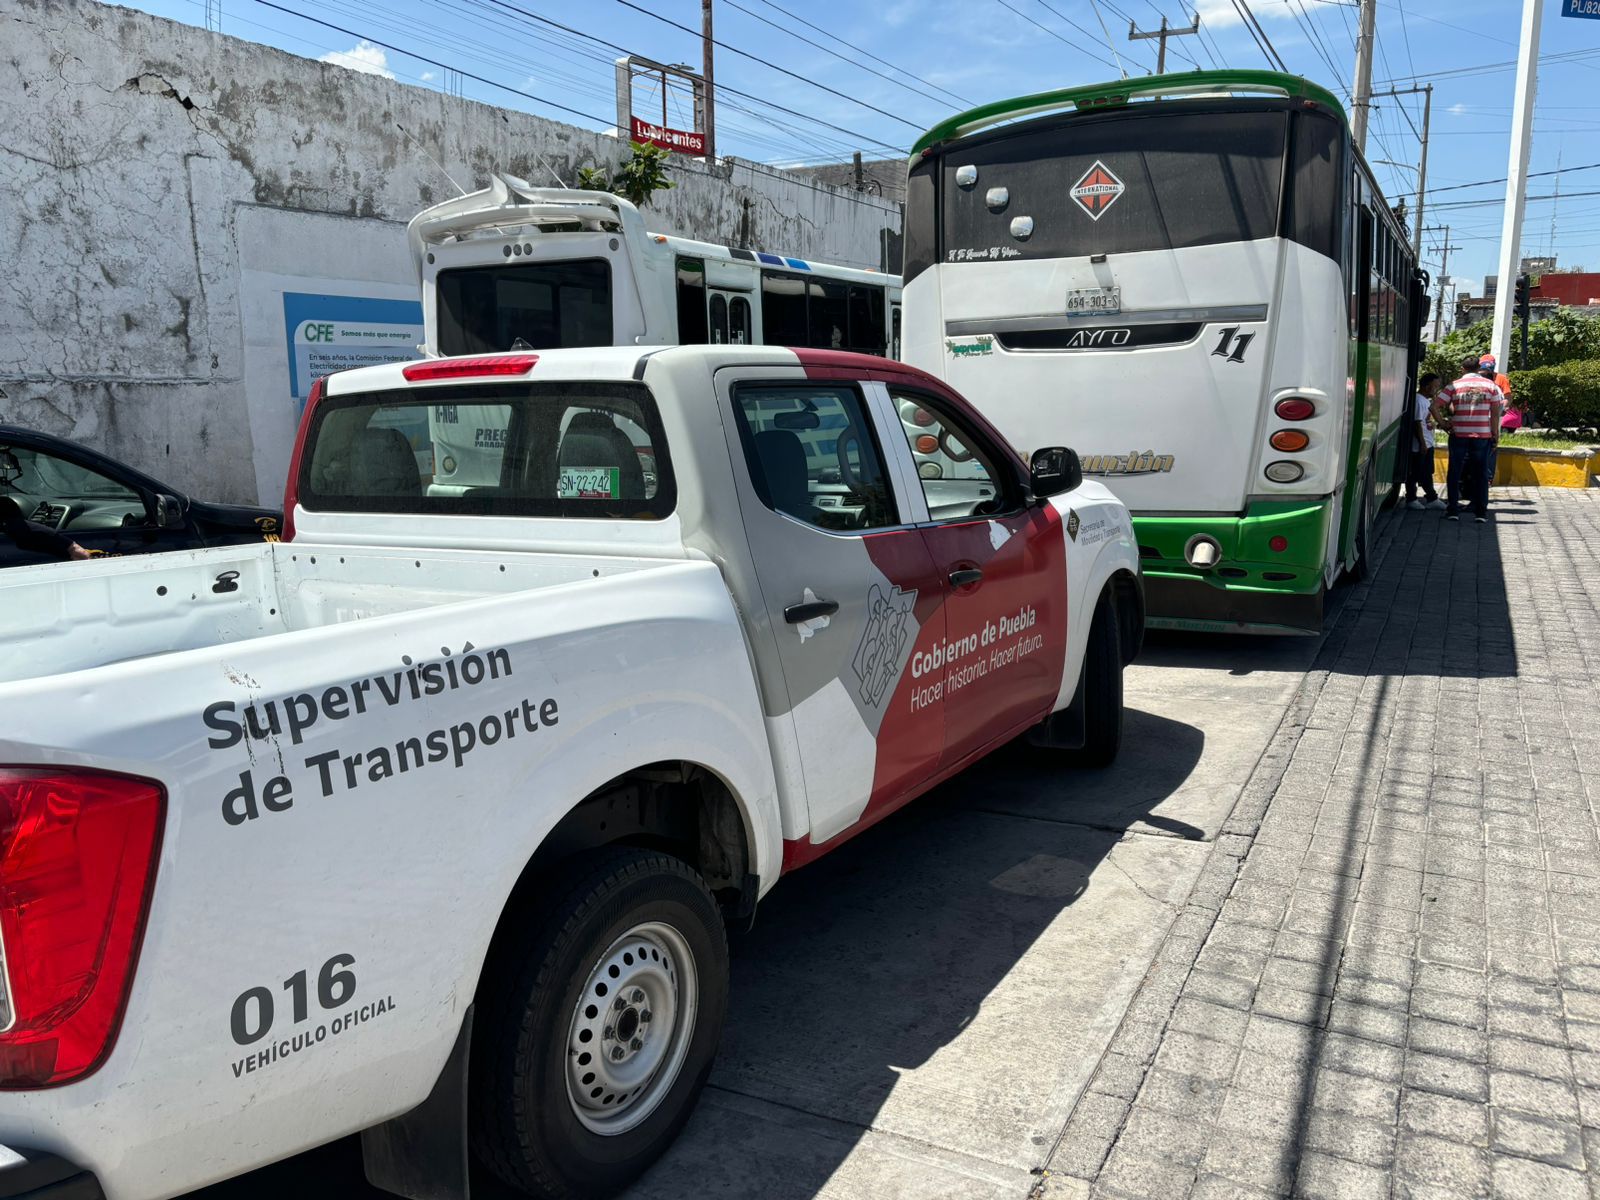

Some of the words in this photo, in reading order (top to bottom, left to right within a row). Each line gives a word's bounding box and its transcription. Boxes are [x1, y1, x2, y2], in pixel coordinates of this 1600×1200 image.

[1074, 185, 1119, 195] INTERNATIONAL
[304, 323, 335, 342] CFE
[309, 362, 347, 370] Electricidad
[1211, 325, 1256, 363] 11
[561, 475, 610, 492] SN-22-242
[910, 679, 946, 713] Hacer
[947, 656, 988, 694] historia.
[989, 645, 1017, 672] Hacer
[1017, 633, 1043, 663] futuro.
[911, 637, 977, 679] Gobierno
[981, 620, 996, 647] de
[999, 604, 1036, 639] Puebla
[202, 641, 513, 750] Supervisión
[221, 769, 294, 826] de
[304, 697, 560, 798] Transporte
[230, 953, 357, 1046] 016
[231, 1024, 328, 1079] VEHÍCULO
[331, 995, 396, 1036] OFICIAL
